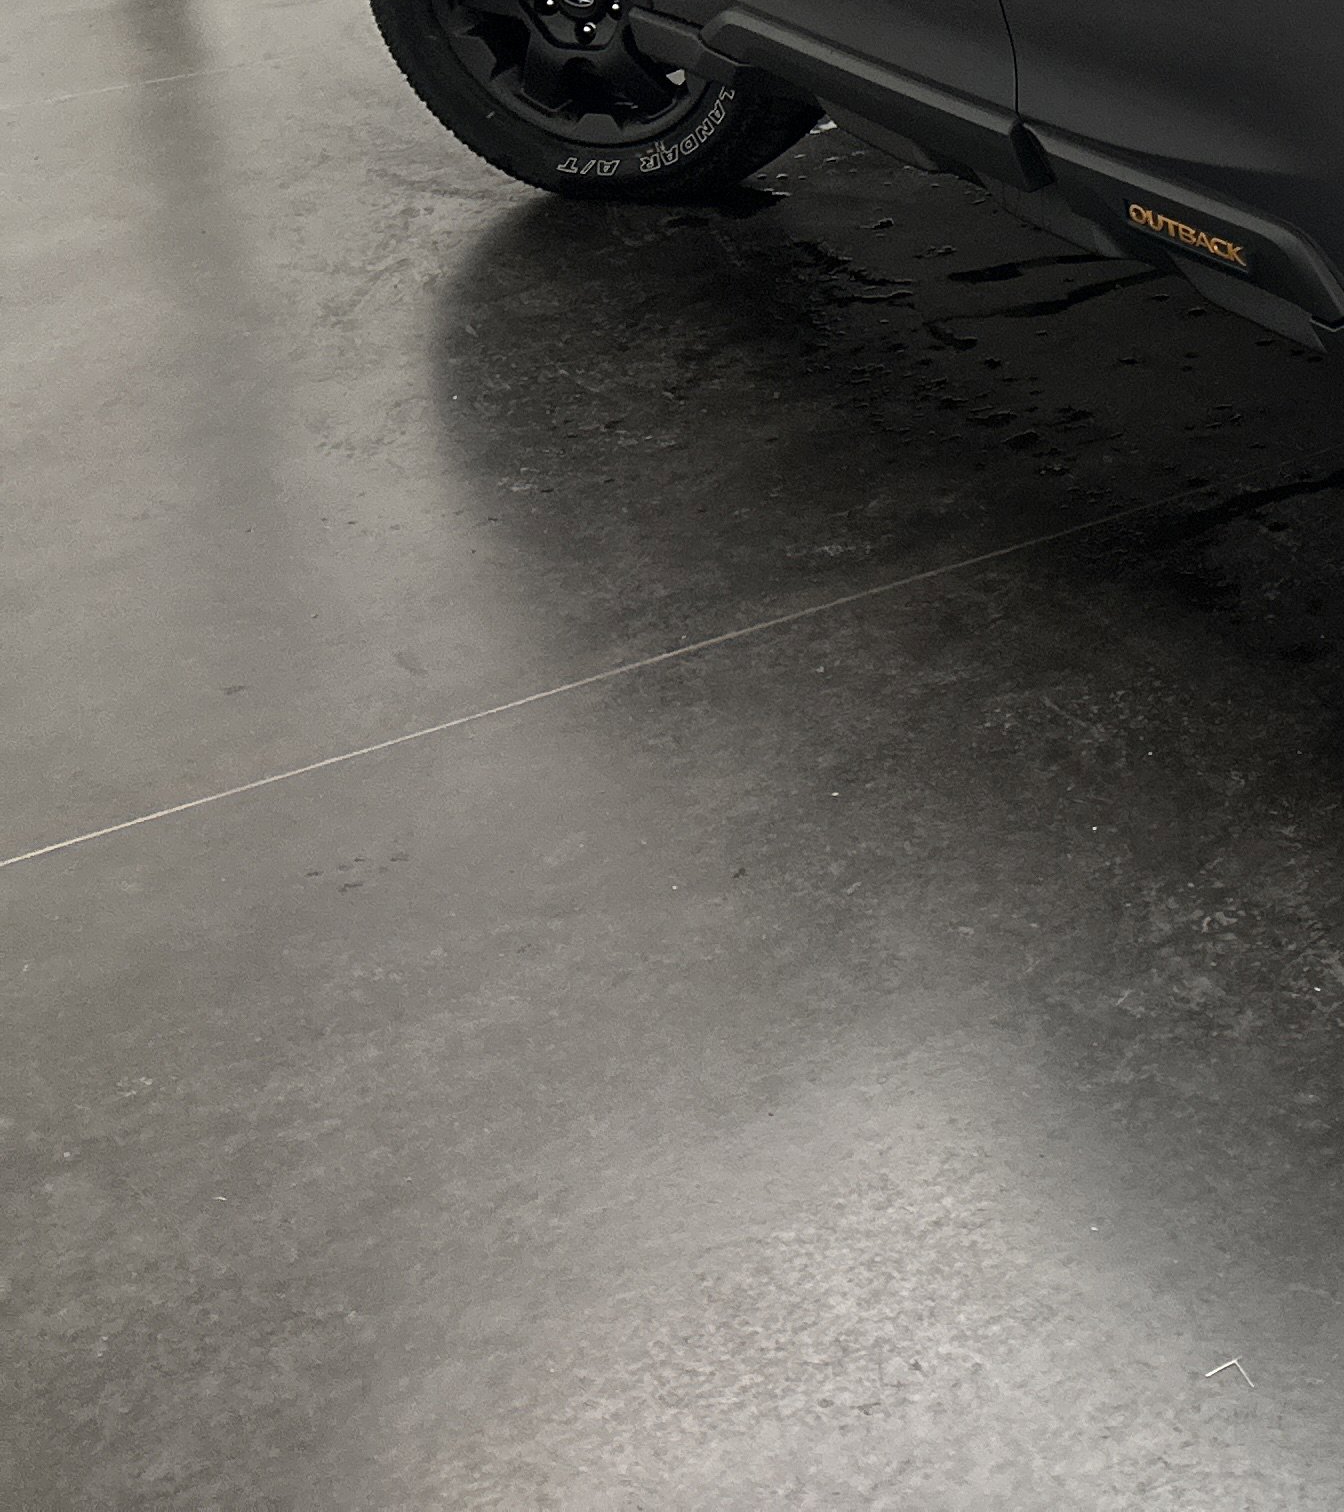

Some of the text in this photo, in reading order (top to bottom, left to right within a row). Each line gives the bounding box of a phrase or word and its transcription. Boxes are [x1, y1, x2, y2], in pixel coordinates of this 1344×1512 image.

[557, 87, 735, 176] LANDAR A/T
[1128, 204, 1247, 267] OUTBACK
